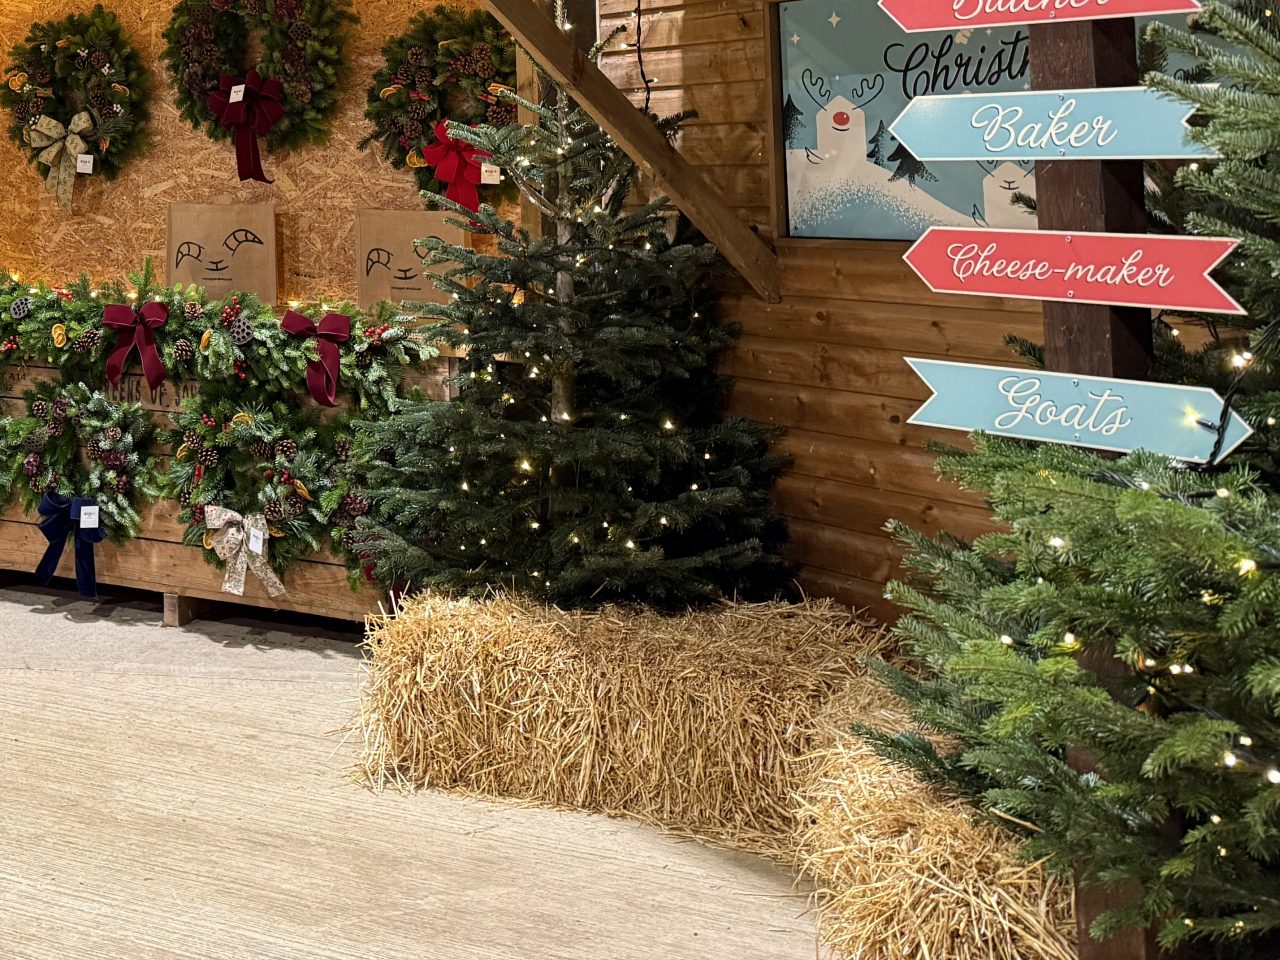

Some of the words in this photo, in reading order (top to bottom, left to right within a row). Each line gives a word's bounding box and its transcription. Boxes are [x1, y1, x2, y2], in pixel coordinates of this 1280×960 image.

[970, 99, 1118, 153] Baker
[946, 242, 1175, 287] Cheese-maker
[994, 376, 1133, 436] Goats
